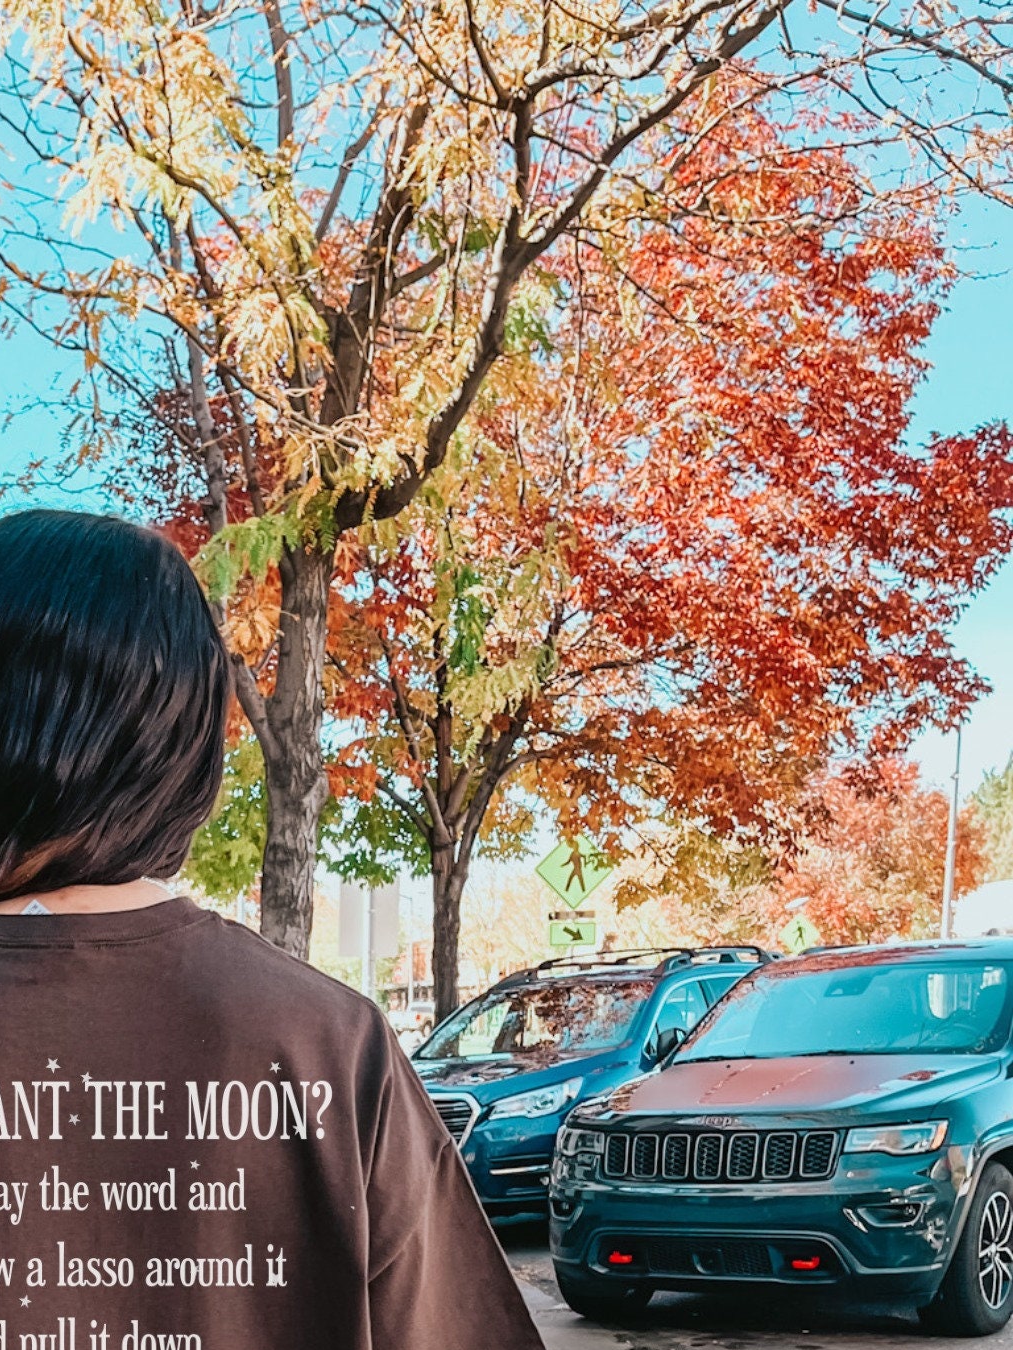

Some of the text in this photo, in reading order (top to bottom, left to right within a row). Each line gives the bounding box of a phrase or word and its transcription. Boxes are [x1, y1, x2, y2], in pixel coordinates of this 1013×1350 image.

[85, 1081, 168, 1140] THE
[185, 1081, 333, 1140] MOON?
[39, 1166, 89, 1211] the
[101, 1168, 178, 1211] word
[189, 1168, 246, 1211] and
[26, 1257, 46, 1287] a
[57, 1241, 134, 1287] lasso
[146, 1244, 254, 1287] around
[266, 1244, 288, 1287] it
